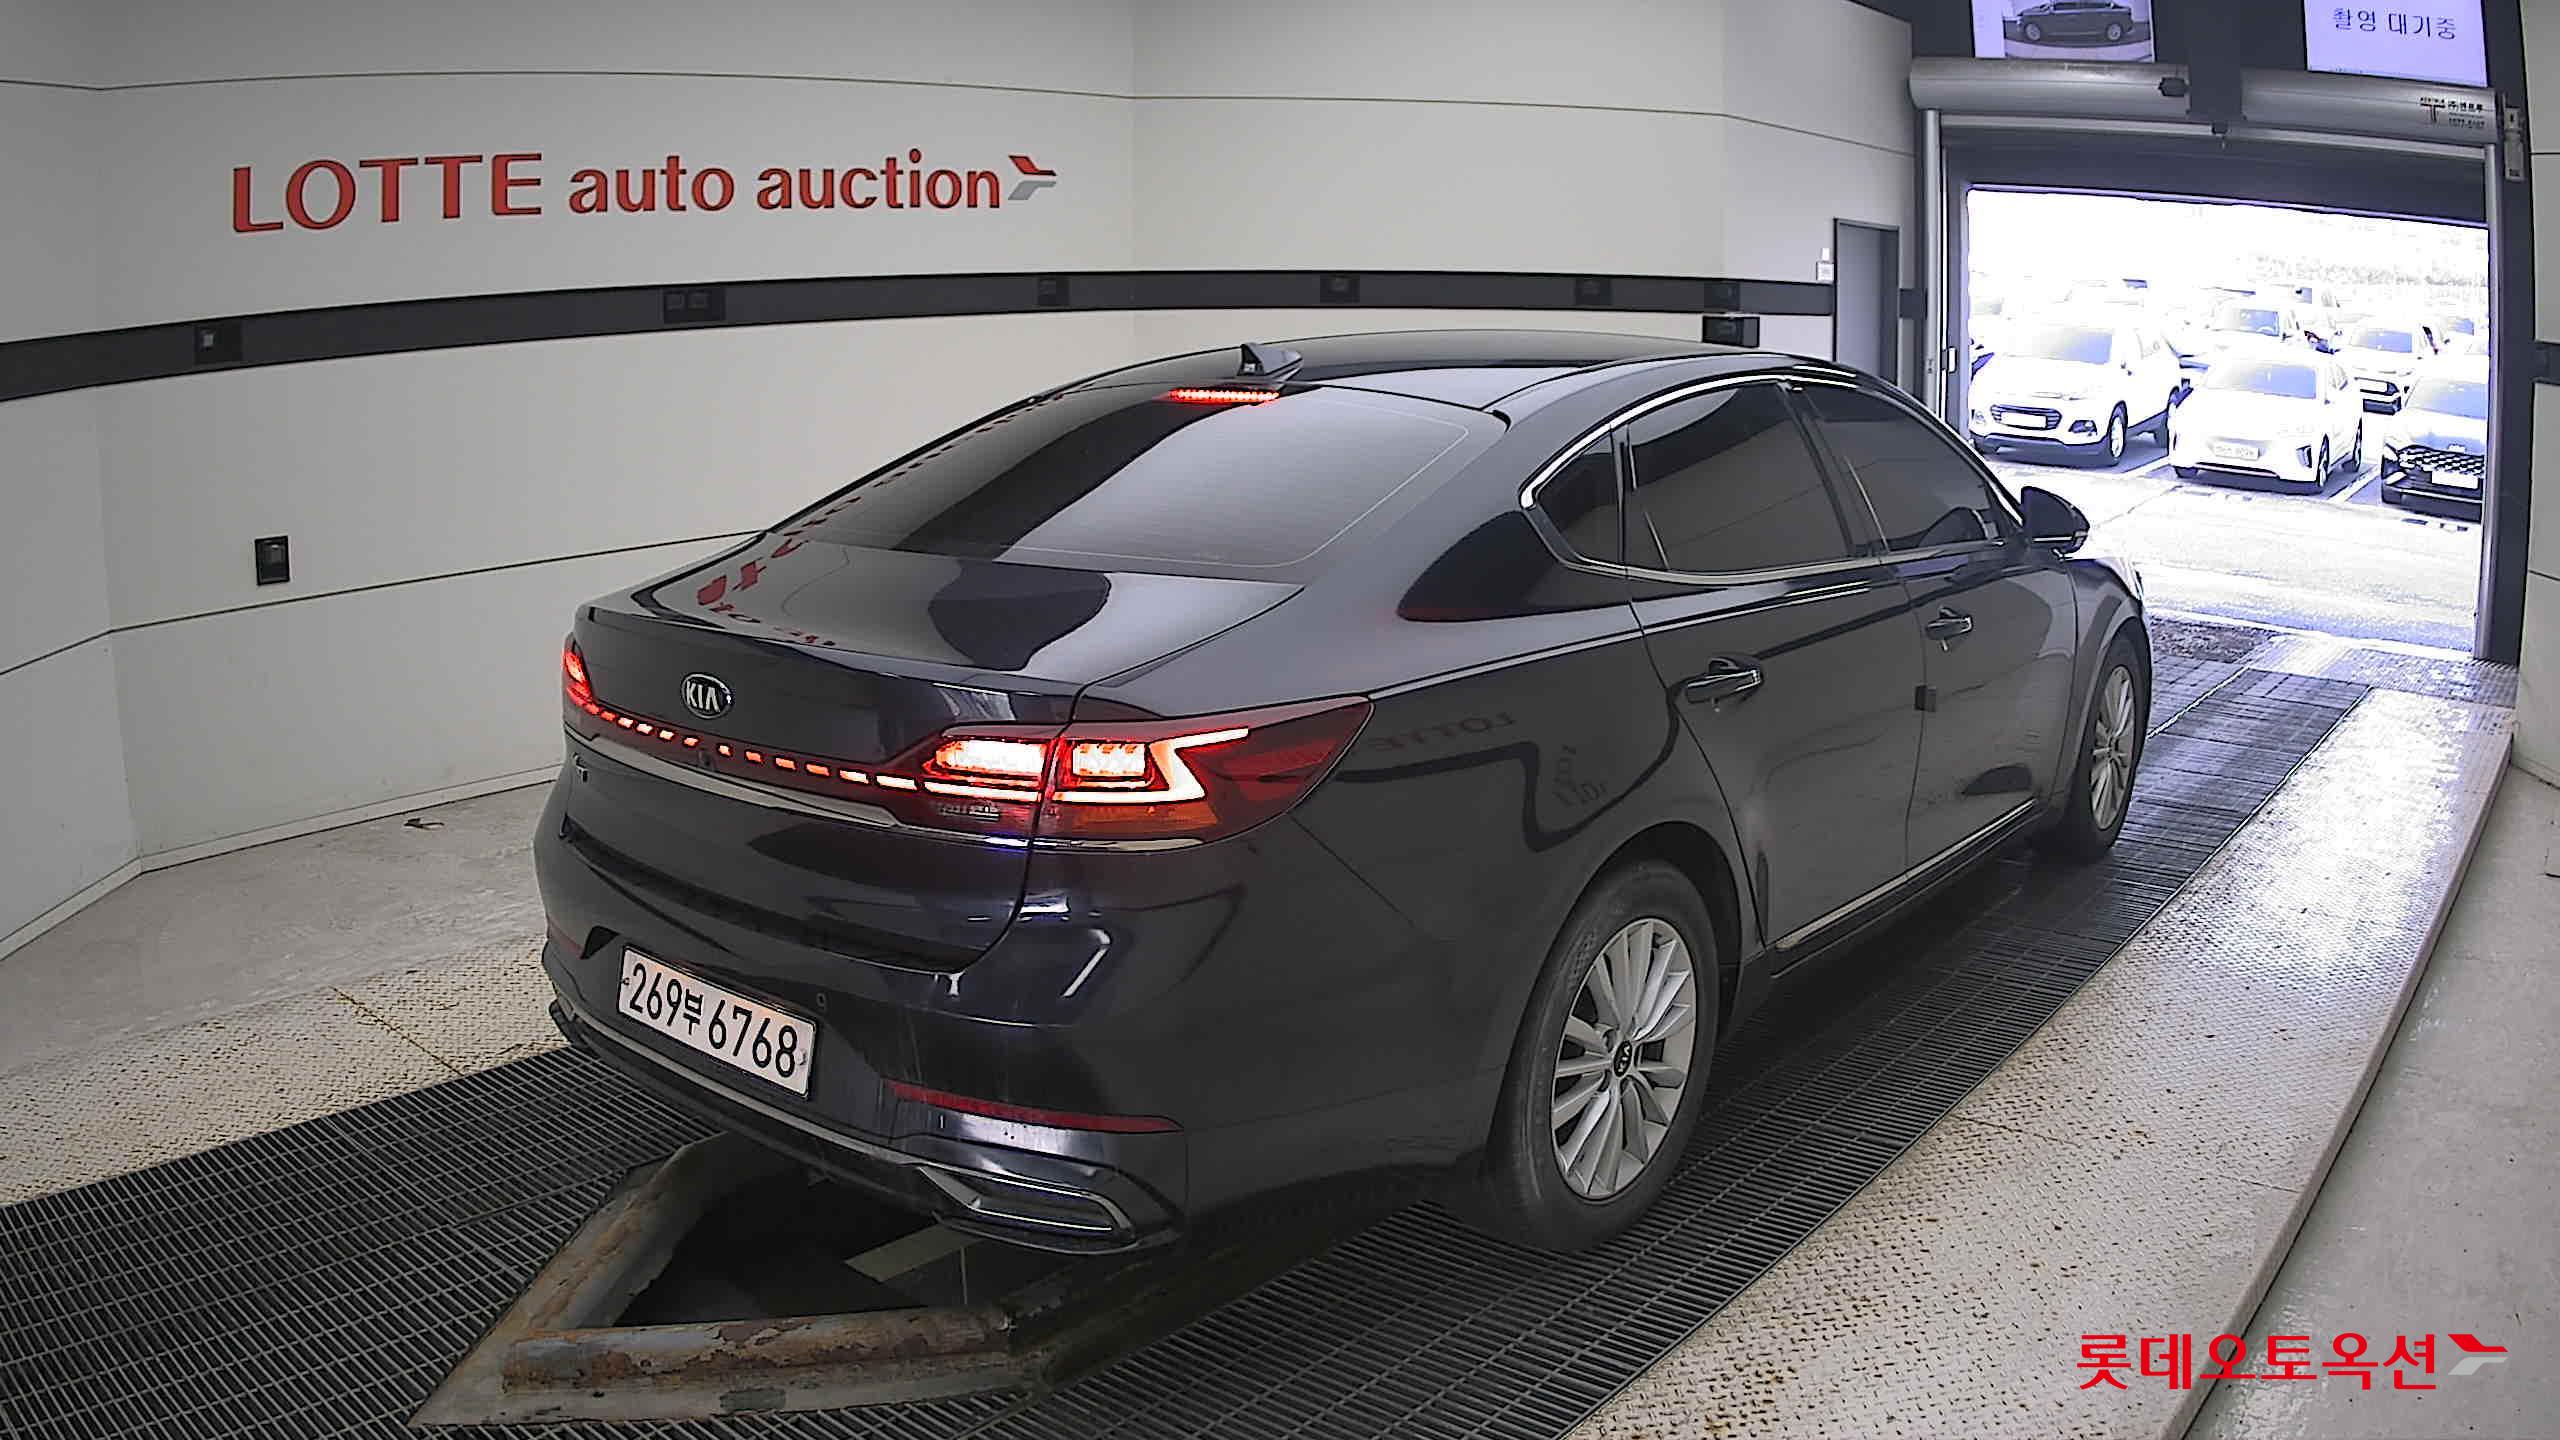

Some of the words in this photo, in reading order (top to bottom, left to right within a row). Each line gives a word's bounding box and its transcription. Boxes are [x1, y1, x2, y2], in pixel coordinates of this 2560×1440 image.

[2333, 8, 2376, 32] 촬영
[2388, 13, 2457, 40] 대기중
[233, 152, 542, 233] LOTTE
[568, 154, 735, 214] auto
[757, 148, 1002, 212] auction
[686, 680, 721, 713] KIA
[630, 962, 798, 1078] 269부6768
